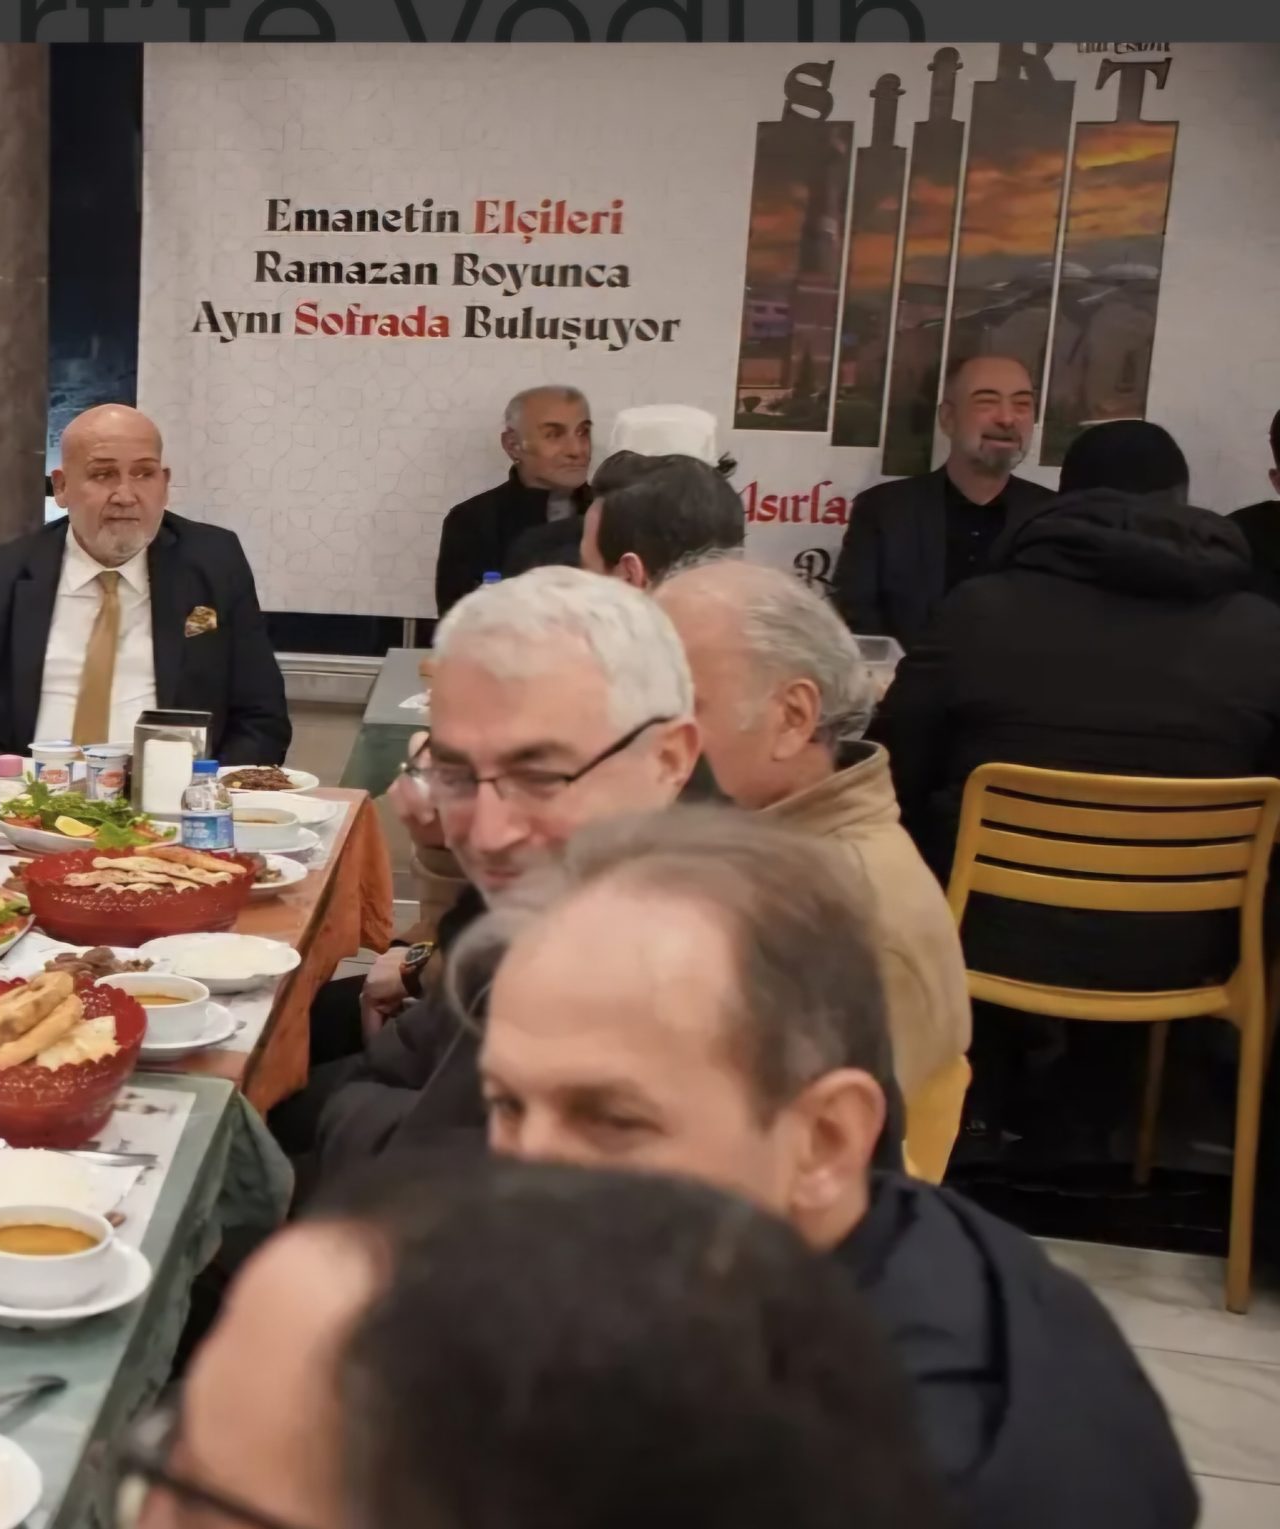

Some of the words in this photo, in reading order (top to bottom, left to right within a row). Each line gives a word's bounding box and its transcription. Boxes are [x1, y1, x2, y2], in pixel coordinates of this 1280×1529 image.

[265, 198, 460, 233] Emanetin
[475, 198, 624, 244] Elçileri
[254, 250, 440, 285] Ramazan
[451, 252, 631, 296] Boyunca
[191, 301, 284, 343] Aynı
[294, 302, 451, 338] Sofrada
[463, 305, 682, 351] Buluşuyor
